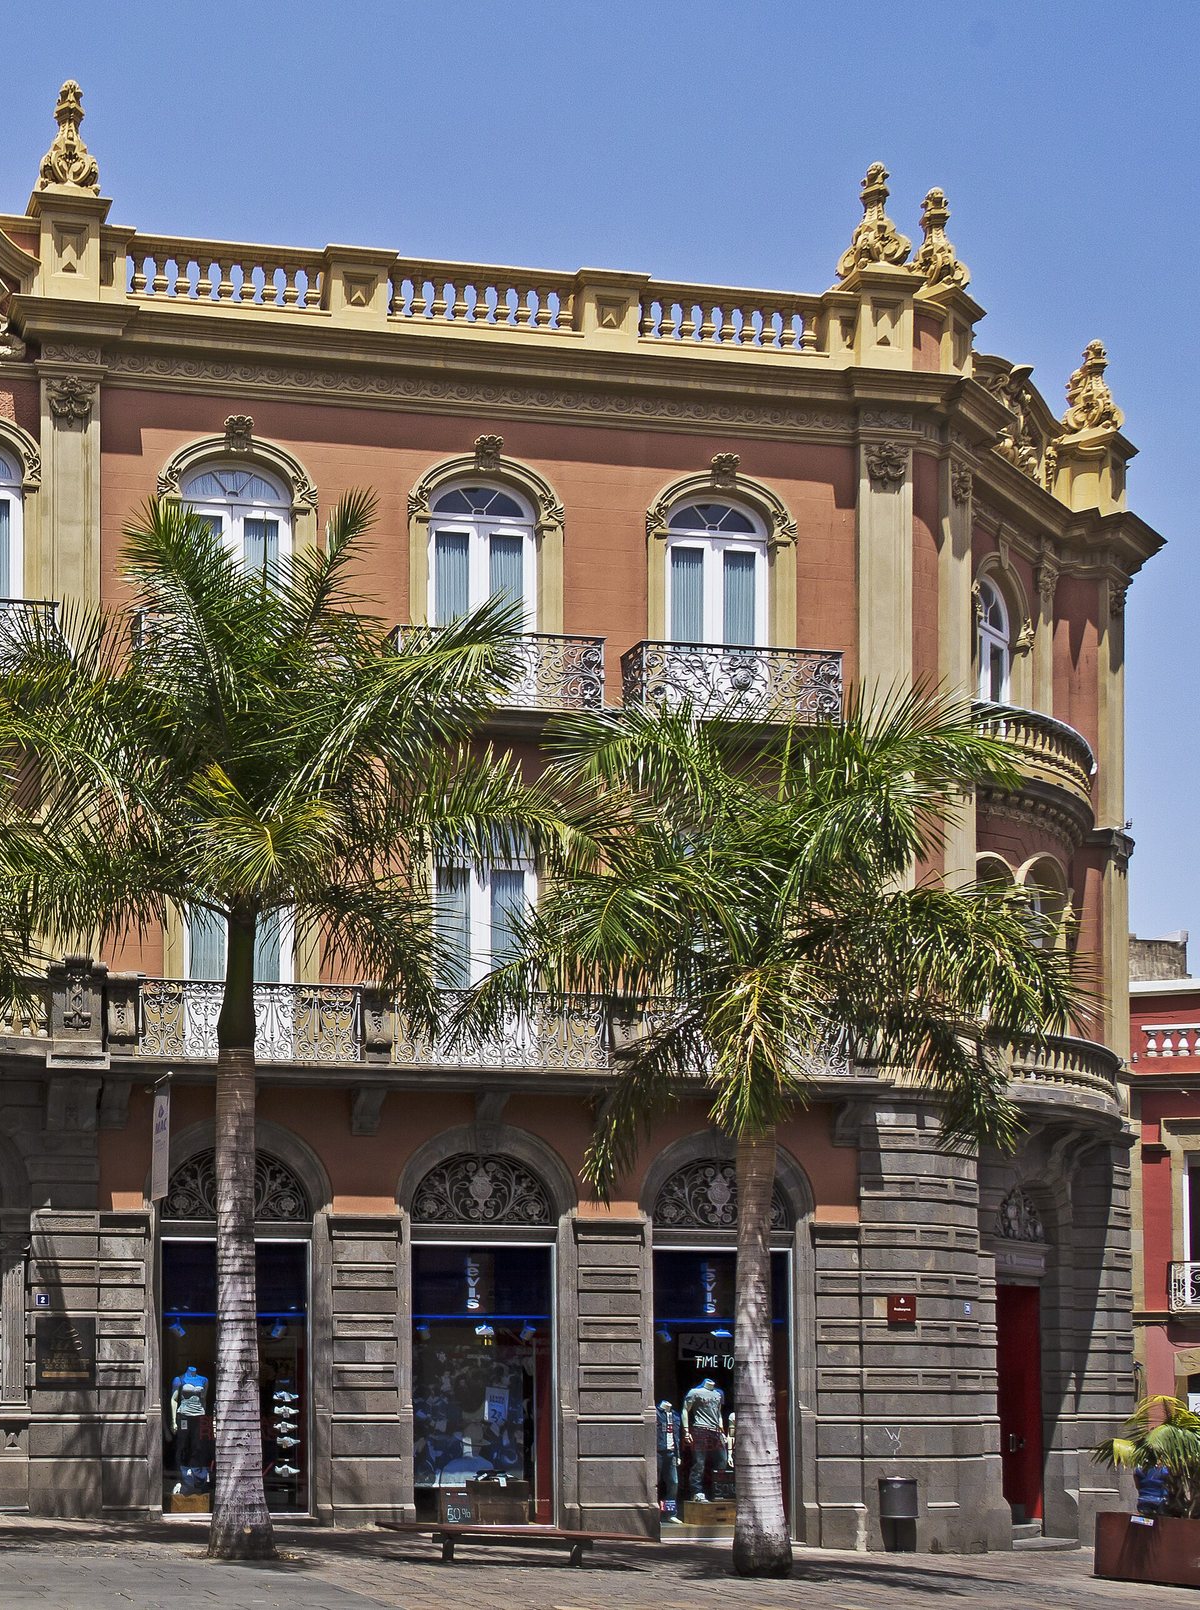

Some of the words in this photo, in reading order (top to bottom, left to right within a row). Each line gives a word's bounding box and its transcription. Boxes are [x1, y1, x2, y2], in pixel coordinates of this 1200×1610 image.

[40, 1296, 46, 1304] 2
[694, 1355, 718, 1369] TIME
[722, 1354, 735, 1370] TO
